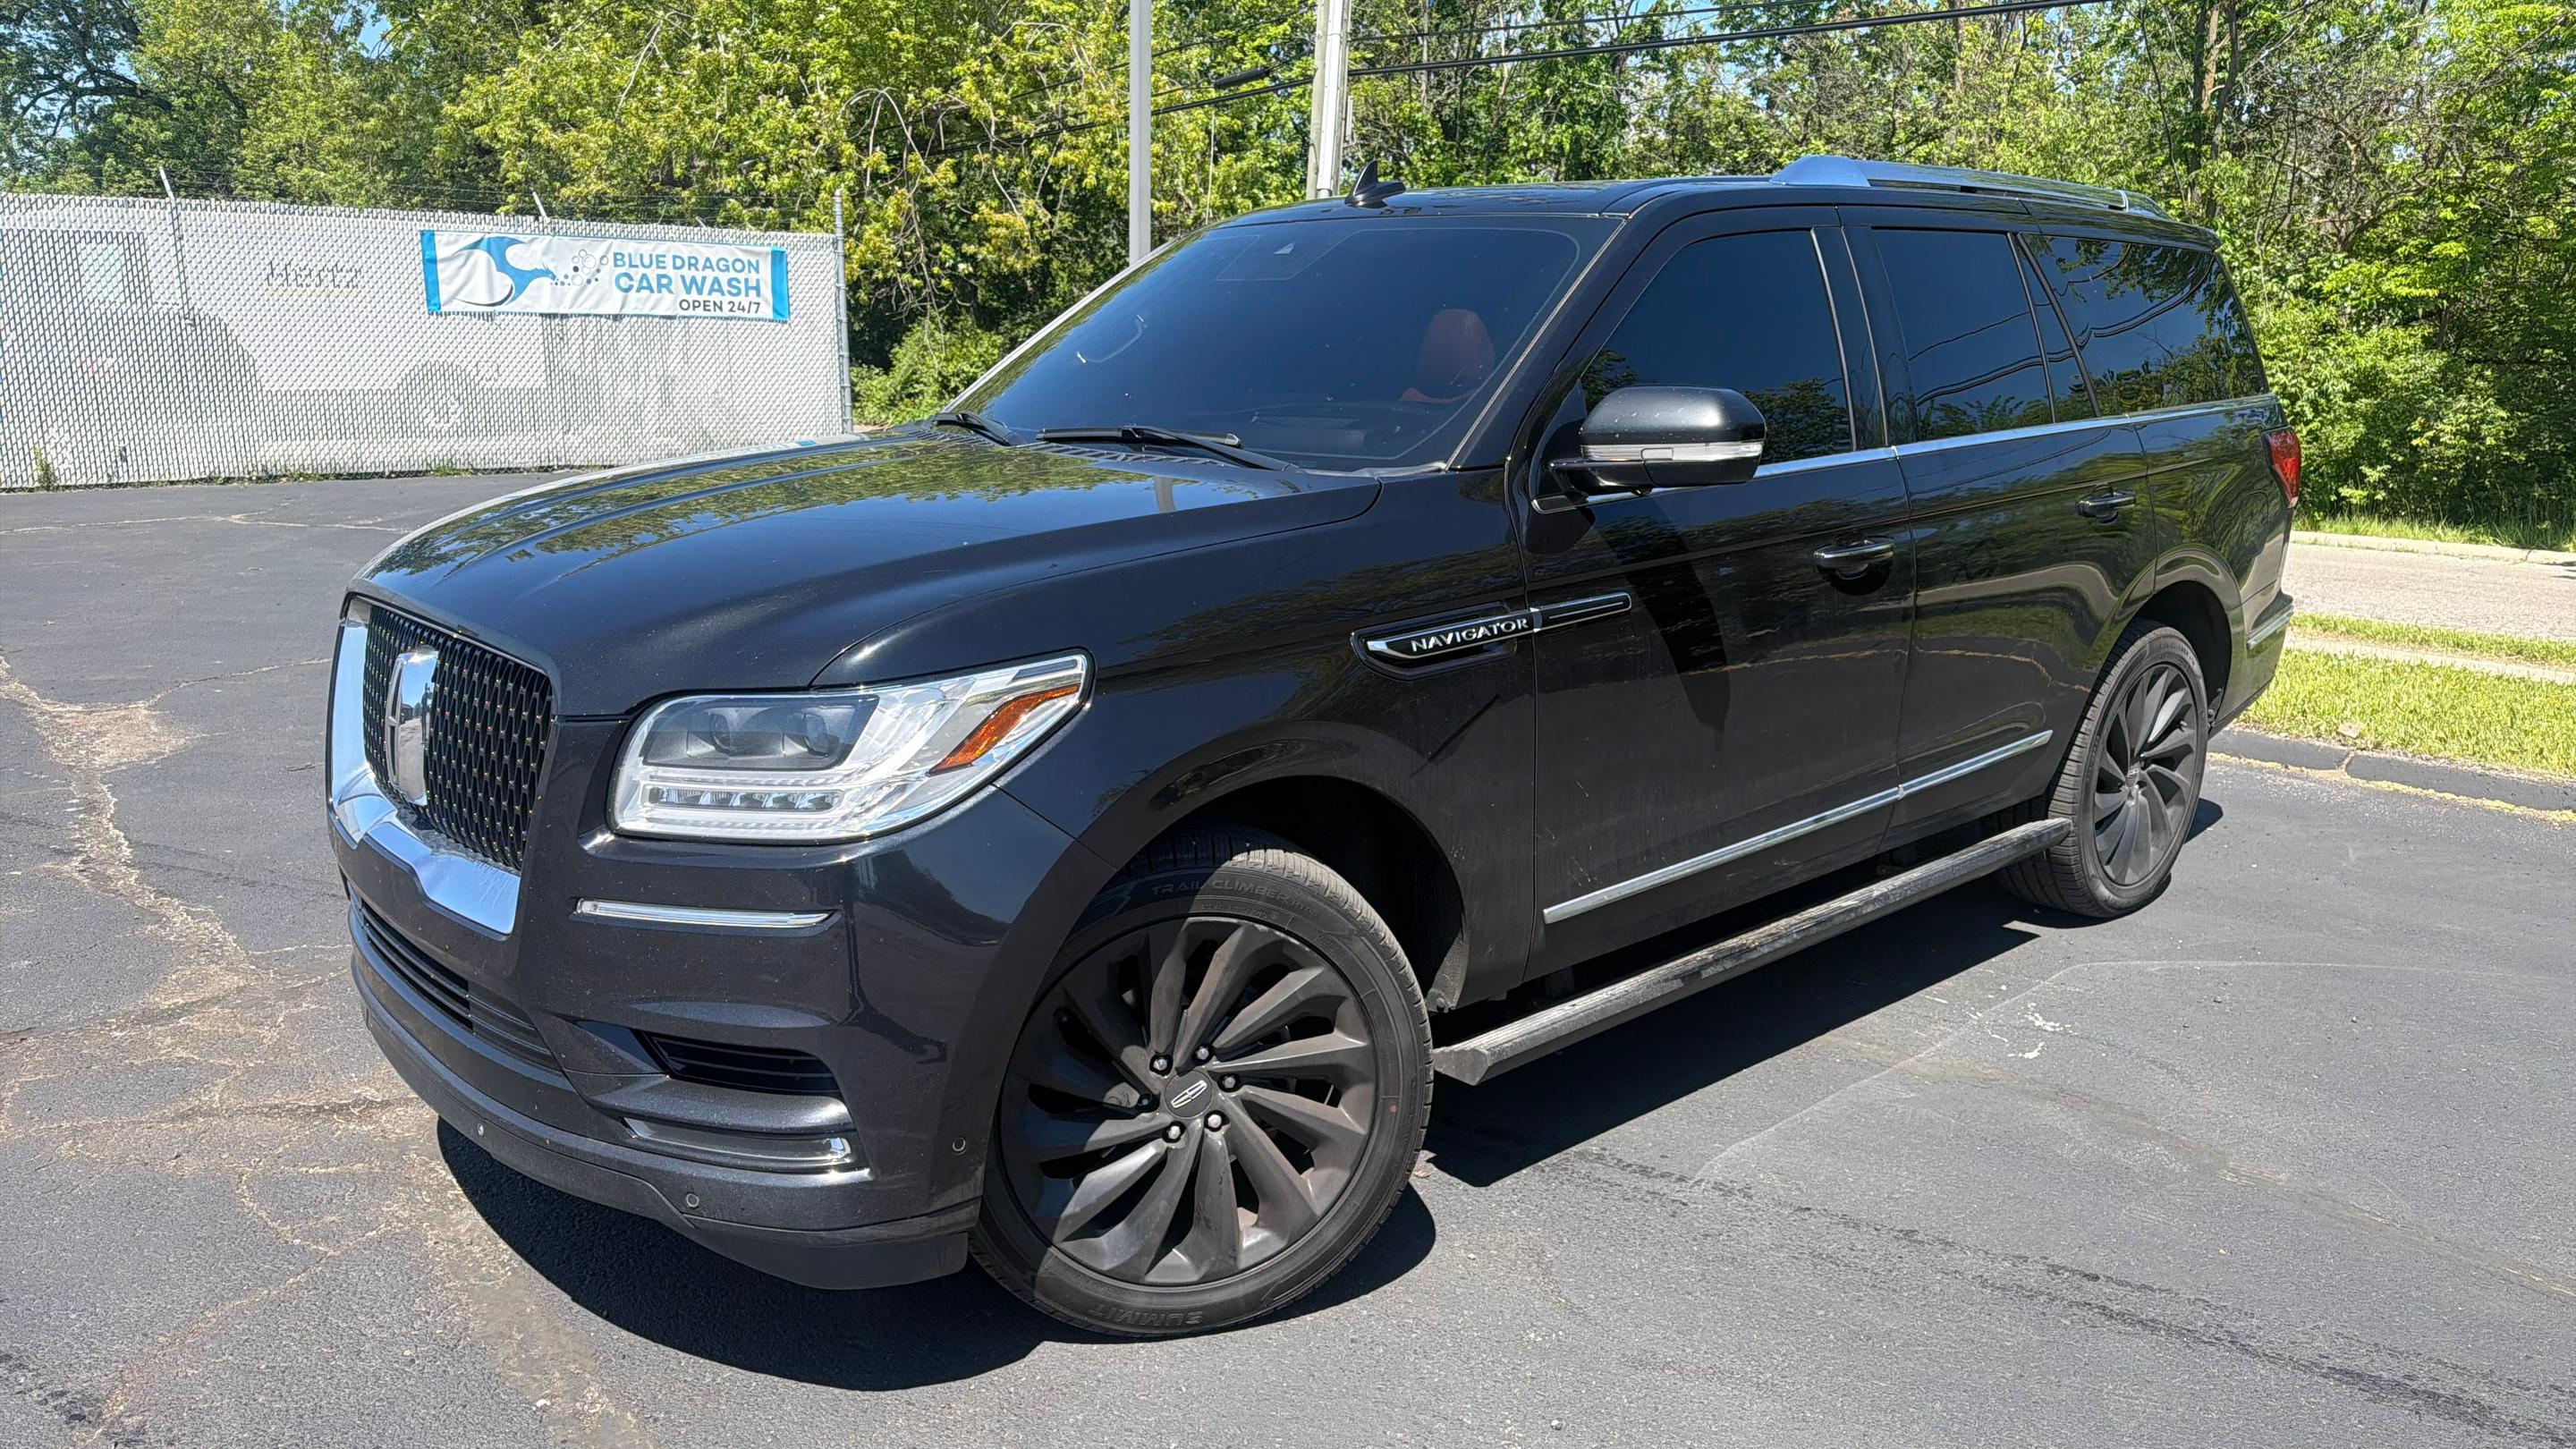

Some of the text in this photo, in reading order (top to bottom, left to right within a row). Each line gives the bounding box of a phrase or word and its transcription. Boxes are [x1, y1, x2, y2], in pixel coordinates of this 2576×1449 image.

[266, 259, 361, 289] Hertz
[613, 251, 759, 275] BLUE DRAGON
[614, 272, 761, 298] CAR WASH
[679, 299, 761, 315] OPEN 24/7
[1411, 617, 1529, 652] NAVIGATOR
[1151, 878, 1289, 905] TRAIL CLIMBER
[1088, 1304, 1204, 1326] SUMMIT
